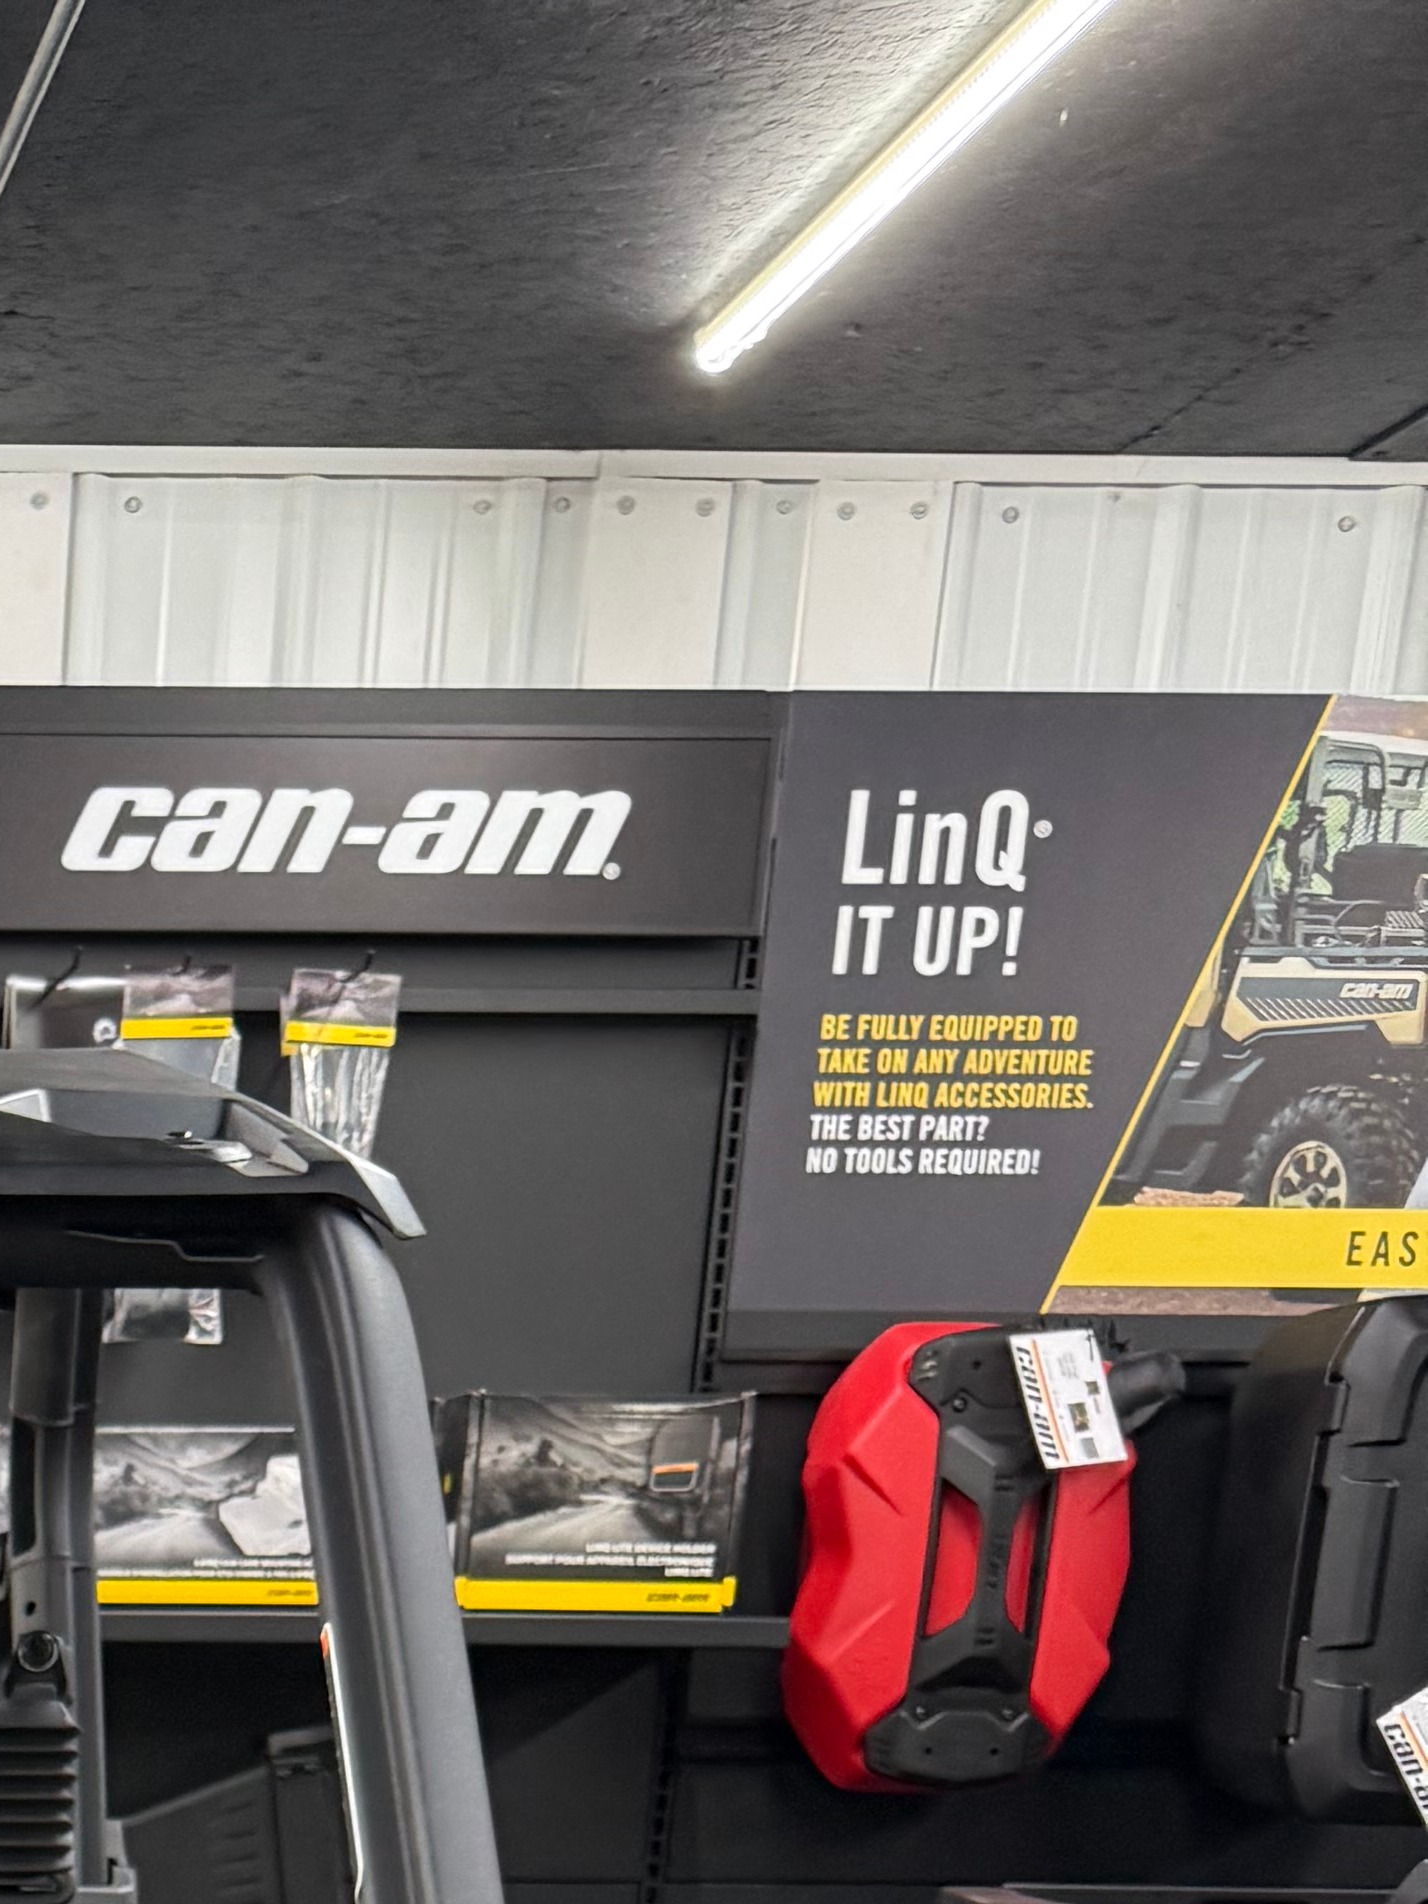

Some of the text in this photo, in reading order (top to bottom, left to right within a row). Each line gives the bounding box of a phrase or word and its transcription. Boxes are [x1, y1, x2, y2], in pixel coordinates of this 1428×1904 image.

[60, 786, 633, 877] can-am
[841, 788, 1031, 892] LinQ
[831, 905, 1025, 978] IT UP!
[820, 1014, 1079, 1043] BE FULLY EQUIPPED TO
[817, 1047, 1094, 1076] TAKE ON ANY ADVENTURE
[813, 1080, 1094, 1109] WITH LINQ ACCESSORIES.
[809, 1113, 990, 1142] THE BEST PART?
[805, 1147, 1041, 1176] NO TOOLS REQUIRED!
[1346, 1230, 1428, 1268] EAS
[1384, 1723, 1428, 1811] can-a
